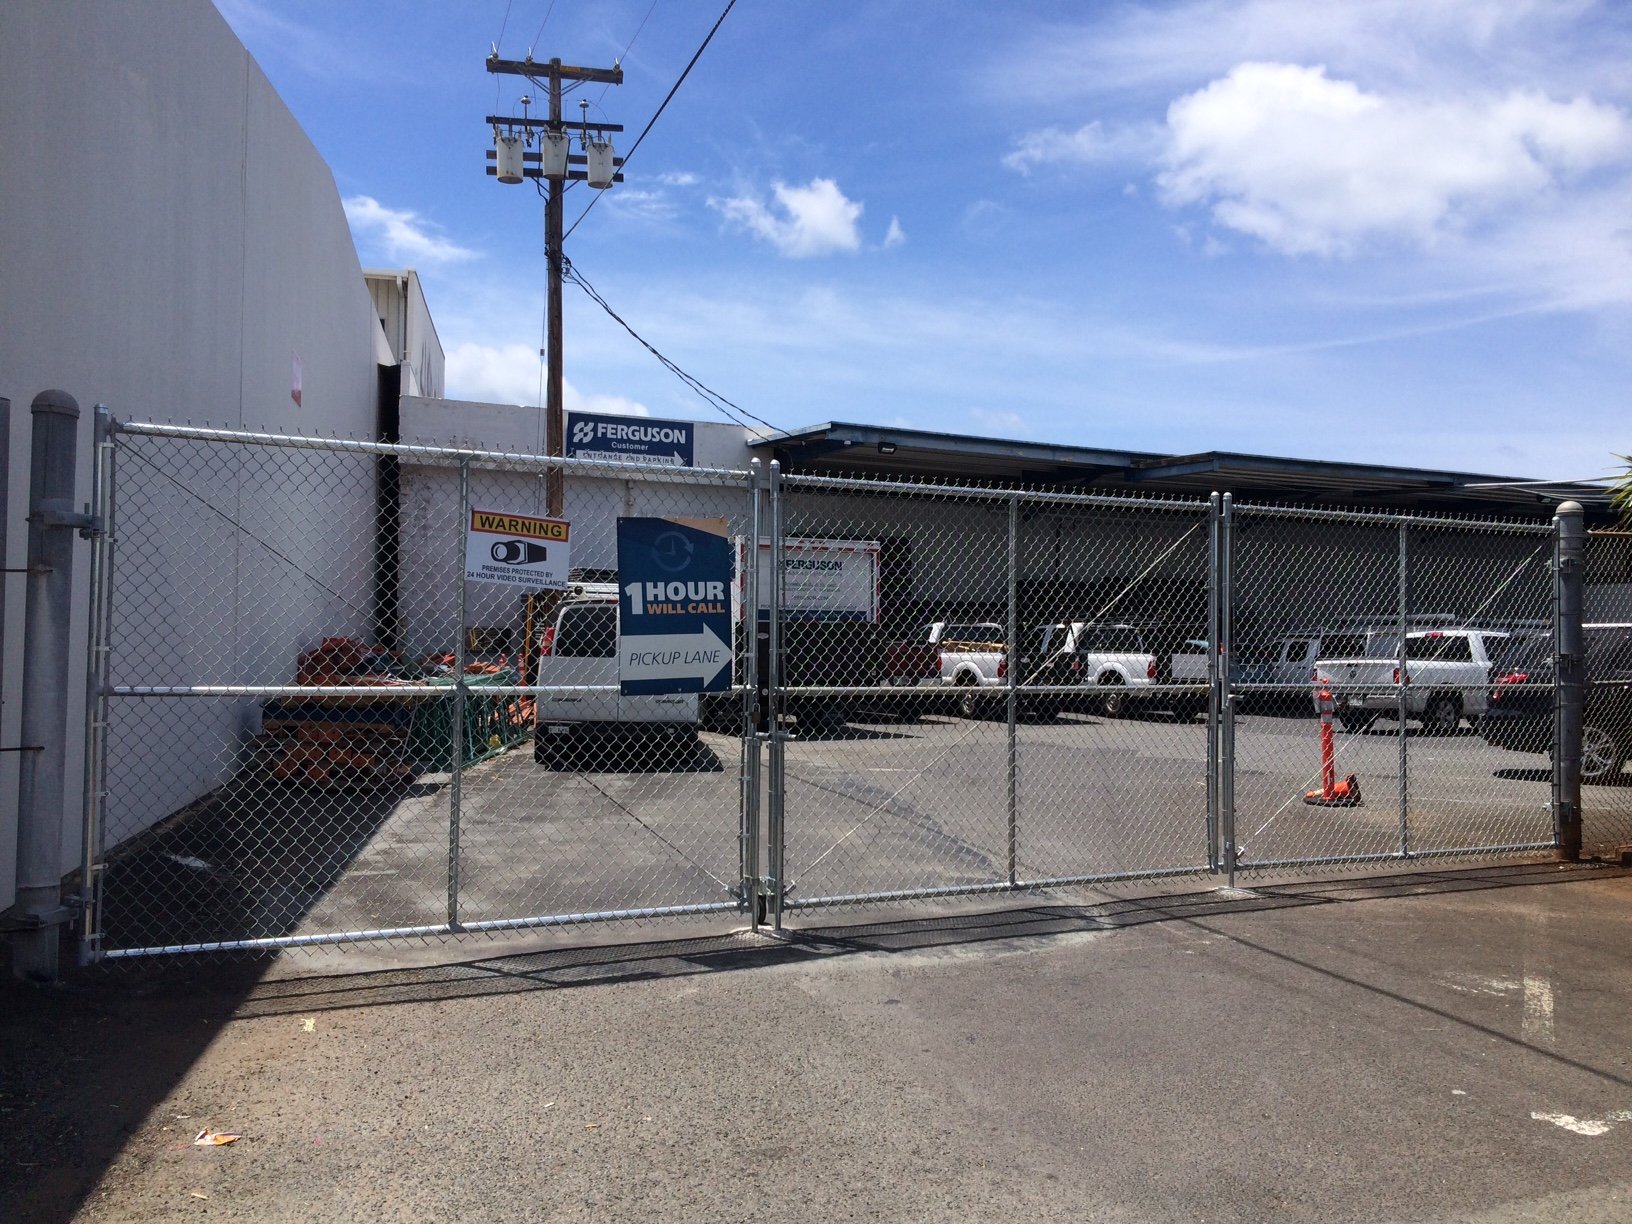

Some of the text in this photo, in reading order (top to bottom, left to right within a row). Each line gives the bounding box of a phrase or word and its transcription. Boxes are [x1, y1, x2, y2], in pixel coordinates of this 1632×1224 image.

[597, 422, 686, 444] FERGUSON
[611, 441, 649, 451] Customer
[480, 515, 562, 537] WARNING
[482, 564, 511, 574] PREMISES
[511, 567, 545, 578] PROTECTED
[785, 559, 843, 571] FERGUSON
[476, 572, 496, 580] HOUR
[497, 574, 517, 582] VIDEO
[518, 576, 566, 587] SURVEILLANCE
[624, 581, 725, 615] 1 HOUR
[647, 602, 725, 615] WILL CALL
[629, 650, 720, 666] PICKUP LANE
